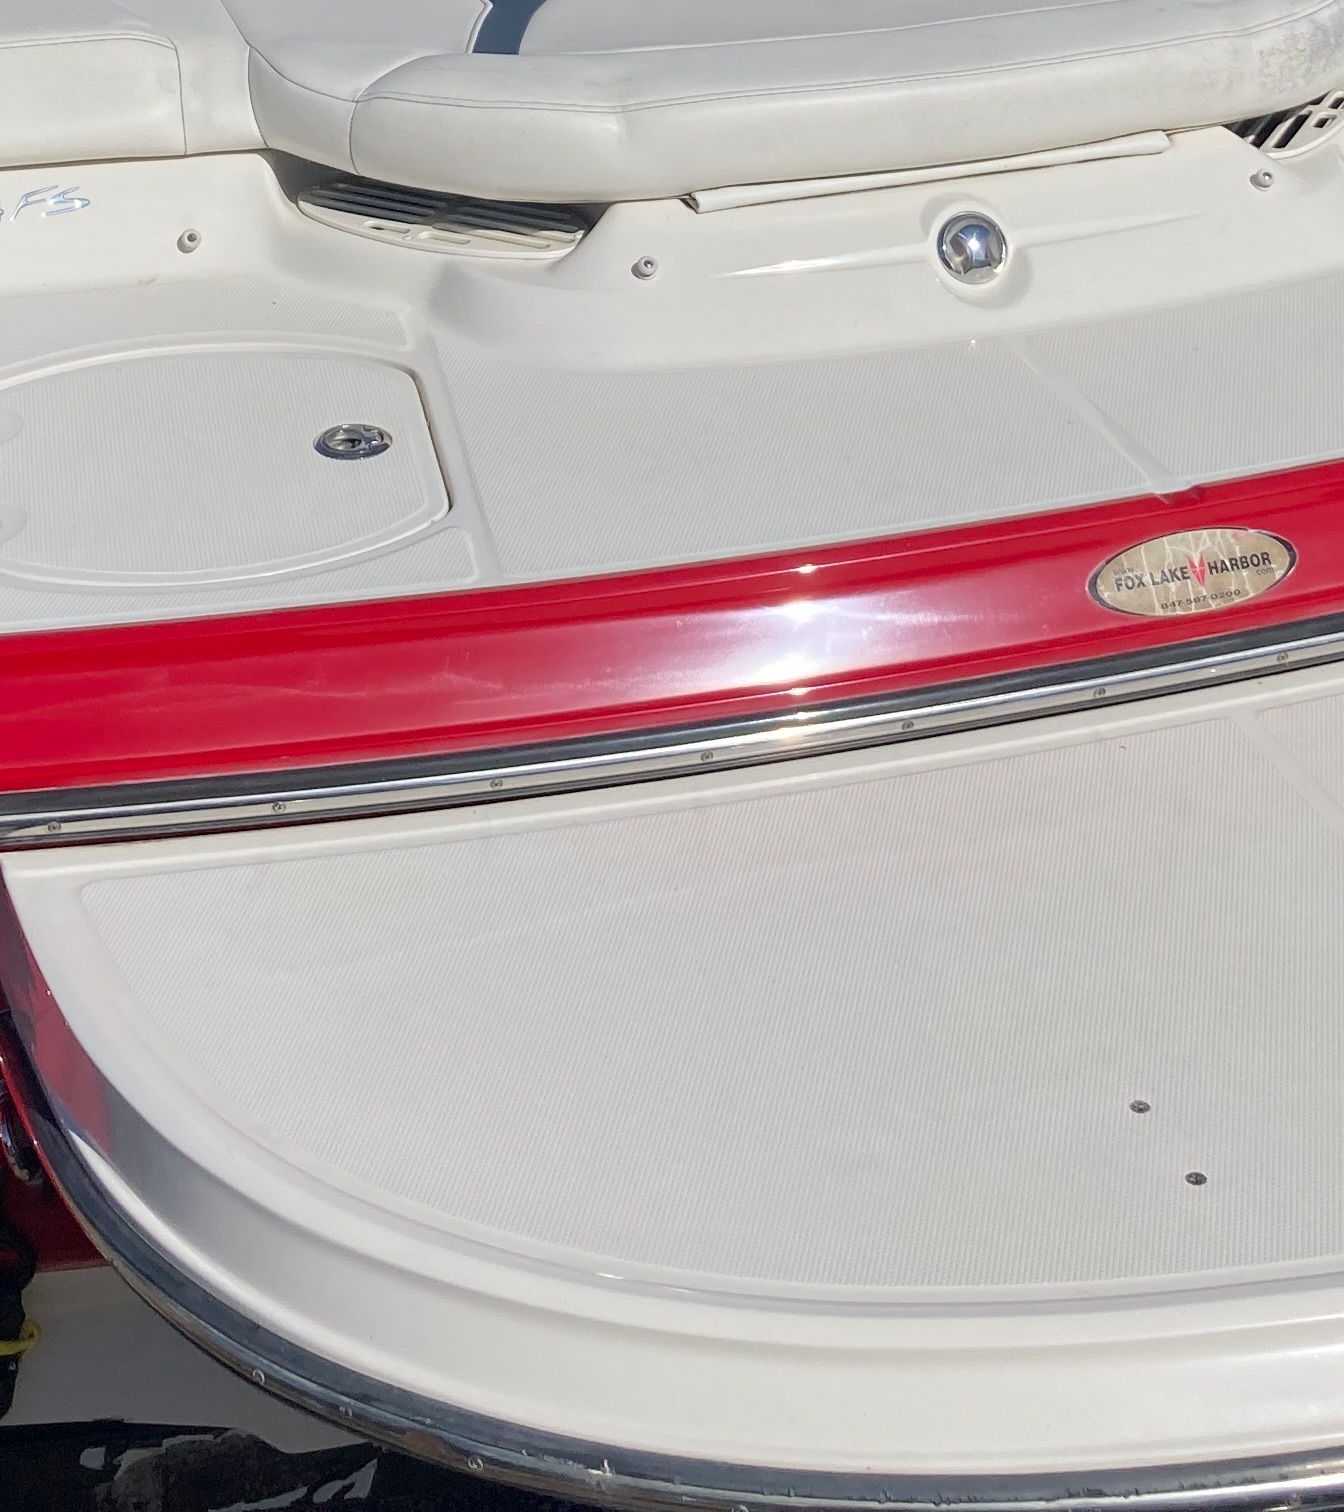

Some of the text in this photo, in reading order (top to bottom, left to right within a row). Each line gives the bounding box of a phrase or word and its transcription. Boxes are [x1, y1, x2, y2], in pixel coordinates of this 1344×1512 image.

[1114, 551, 1273, 593] FOX LAKE HARBOR
[1160, 588, 1242, 610] 847-587-0200
